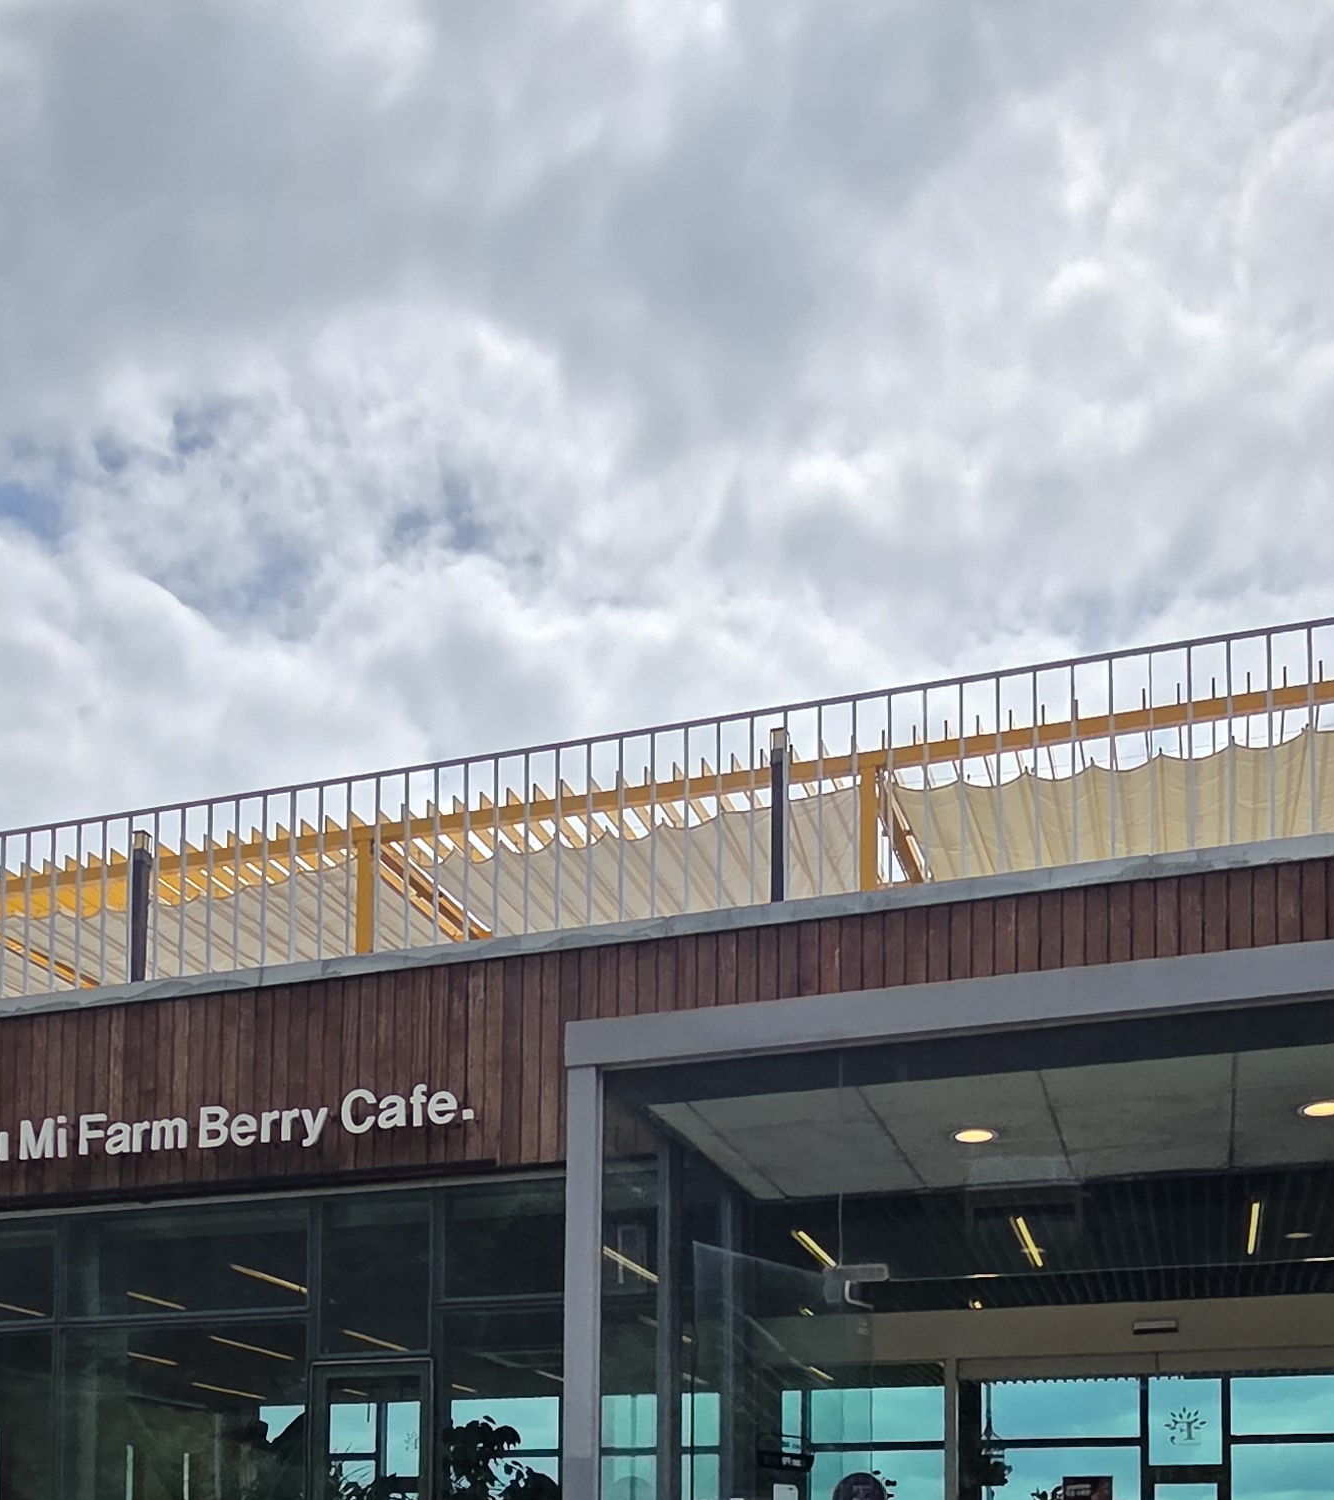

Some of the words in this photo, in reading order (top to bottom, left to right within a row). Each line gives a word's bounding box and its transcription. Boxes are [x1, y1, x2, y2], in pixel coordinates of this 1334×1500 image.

[18, 1115, 68, 1162] Mi
[77, 1111, 188, 1156] Farm
[198, 1102, 329, 1151] Berry
[340, 1083, 475, 1135] Cafe.
